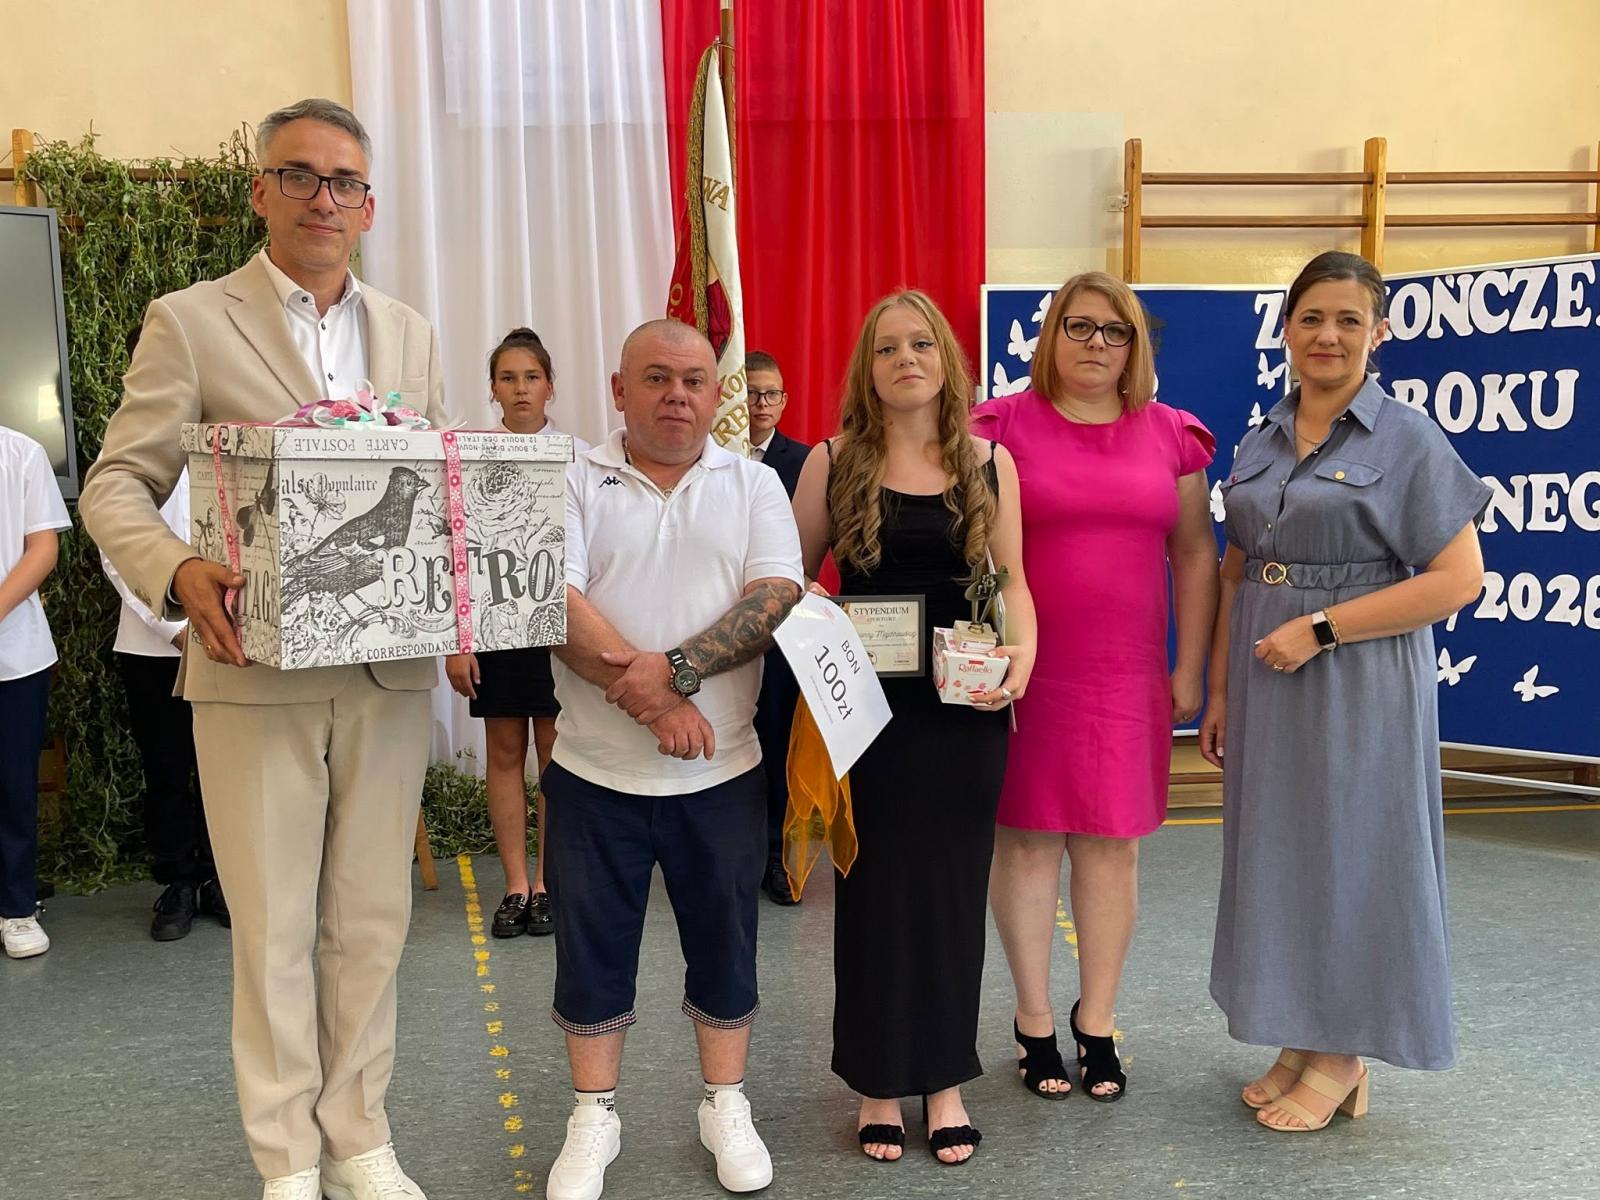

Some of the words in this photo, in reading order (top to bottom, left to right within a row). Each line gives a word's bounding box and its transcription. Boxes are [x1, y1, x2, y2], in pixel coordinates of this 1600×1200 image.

[1391, 369, 1580, 434] ROKU
[295, 438, 356, 451] POSTALE
[367, 439, 409, 451] CARTE
[1477, 471, 1600, 533] NEG
[377, 547, 556, 616] RETRO
[854, 606, 909, 616] STYPENDIUM
[366, 640, 460, 661] CORRESPONDANCE
[841, 640, 861, 675] BON
[814, 645, 854, 721] 100zł
